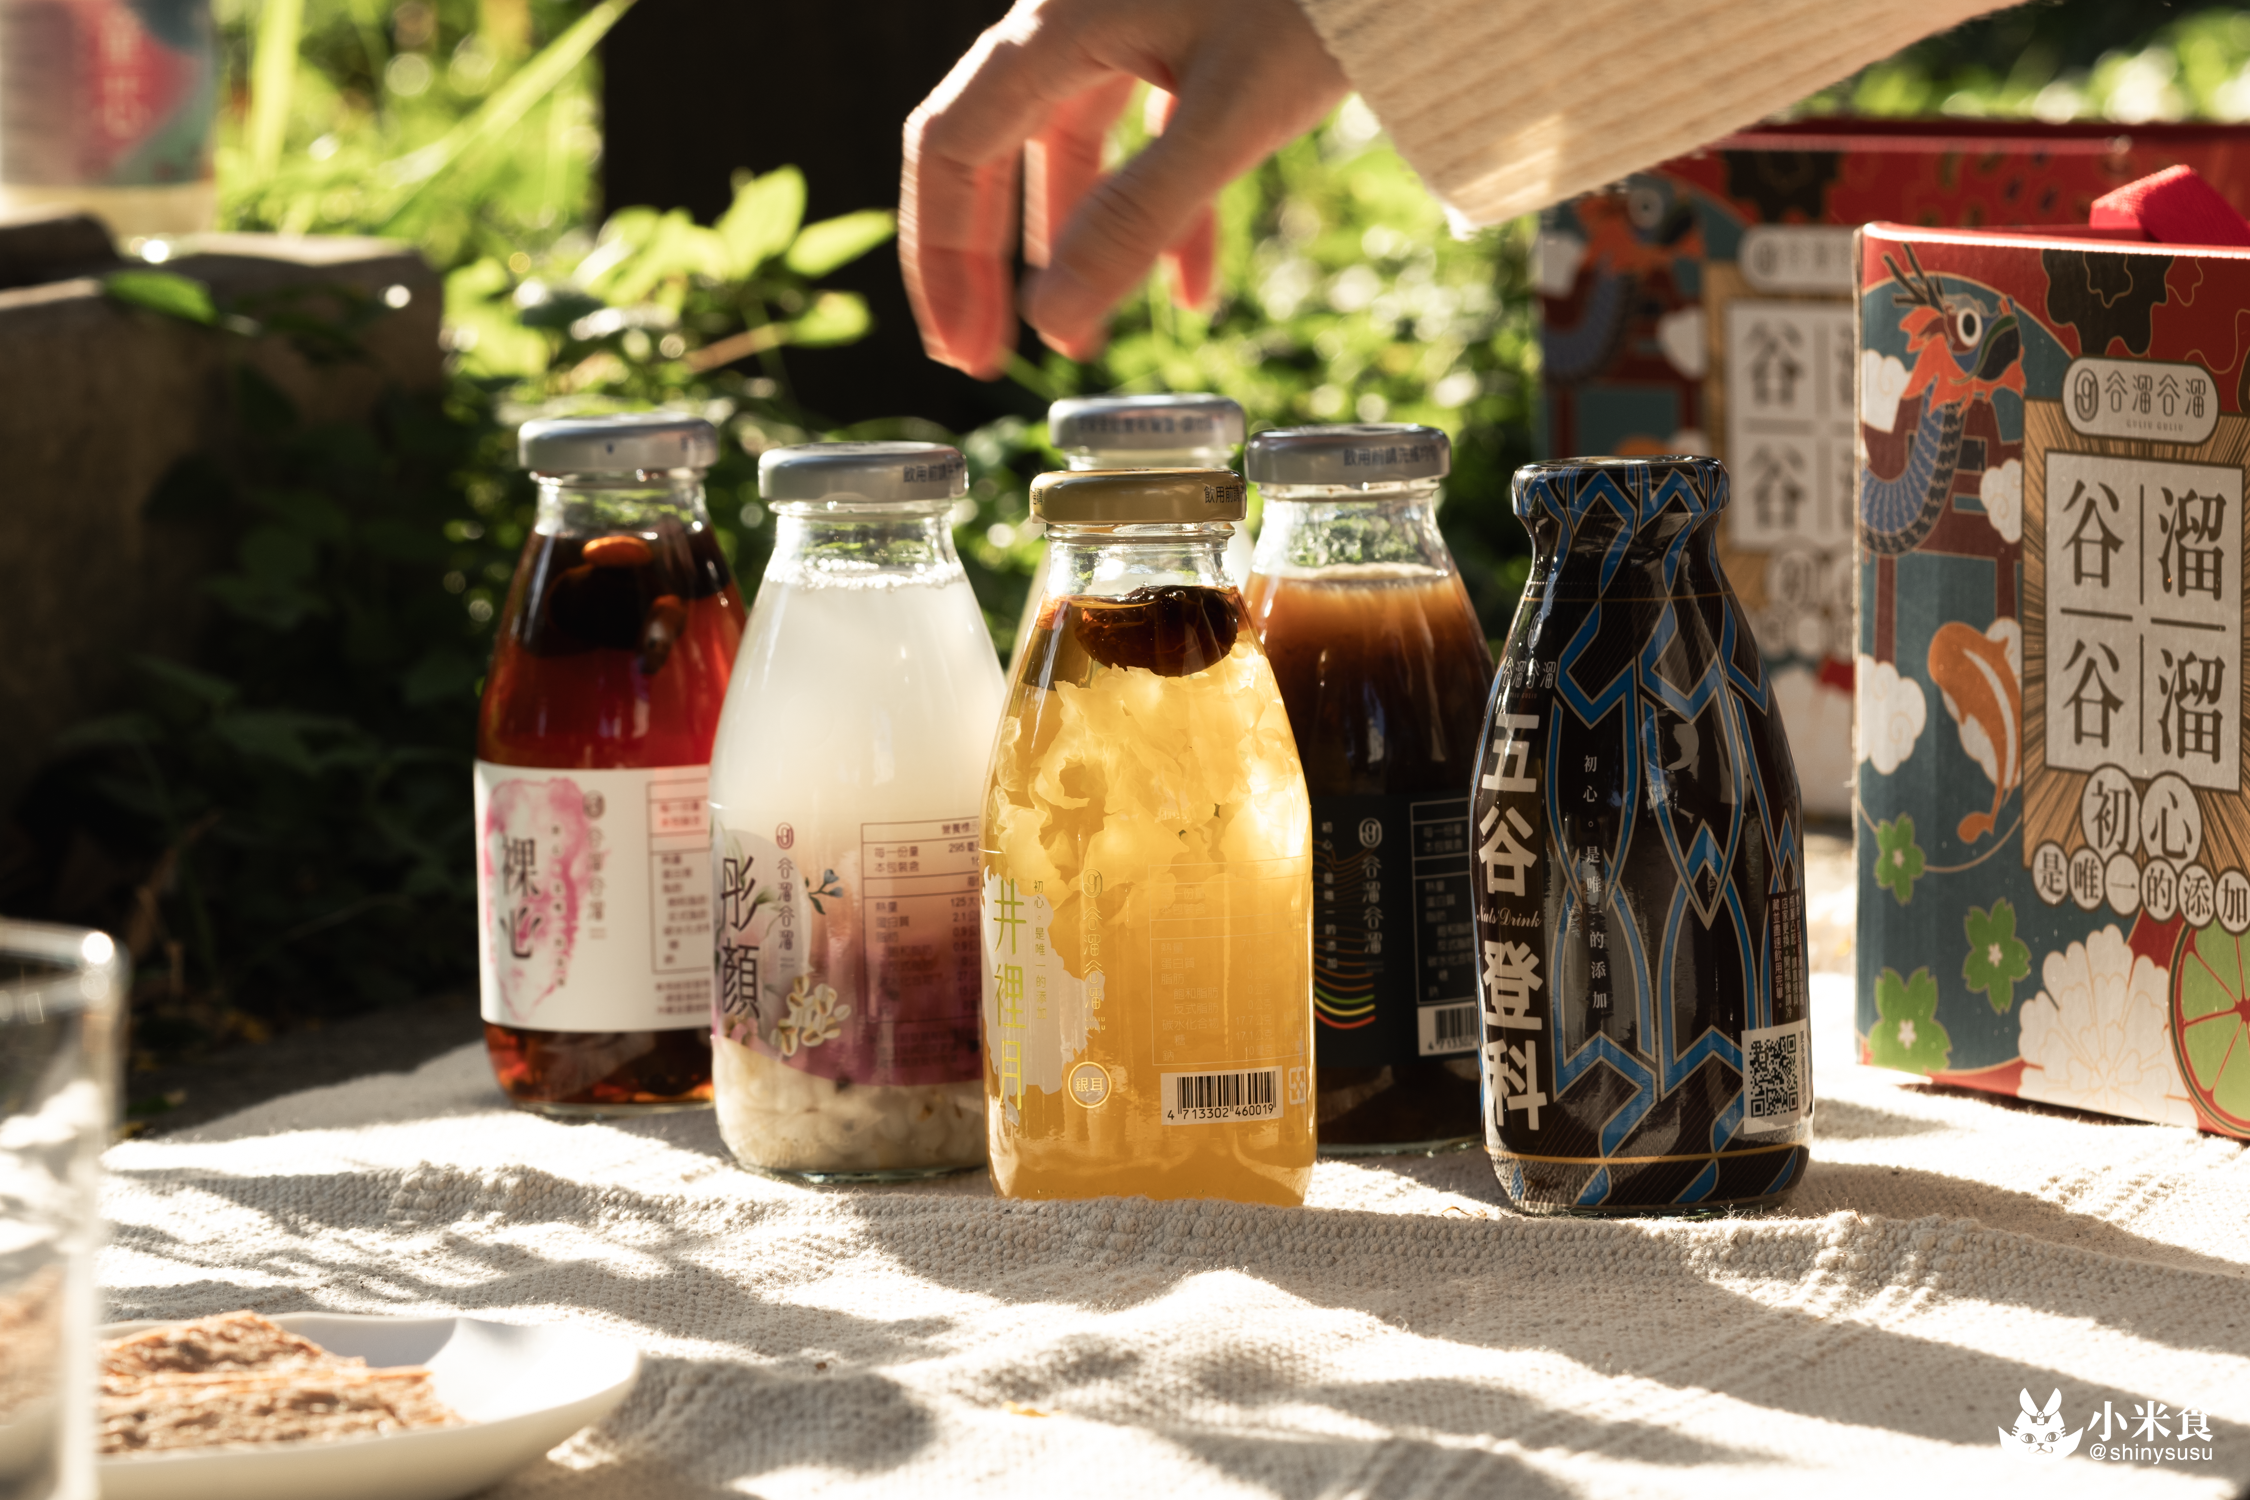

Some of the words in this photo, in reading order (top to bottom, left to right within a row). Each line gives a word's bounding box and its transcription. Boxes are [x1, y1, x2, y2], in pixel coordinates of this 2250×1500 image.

[2105, 369, 2206, 418] 谷溜谷溜
[2090, 780, 2193, 860] 初心
[777, 857, 795, 951] 谷溜谷溜
[2039, 852, 2248, 924] 是唯一的添加
[721, 855, 760, 1020] 彤顏
[1033, 879, 1047, 1020] 初心。是唯一的添加
[1083, 906, 1105, 1010] 谷溜谷溜
[1160, 956, 1196, 970] 蛋白質
[993, 877, 1027, 1111] 井裡月
[1160, 972, 1185, 986] 脂肪
[1173, 986, 1219, 1001] 飽和脂肪
[1173, 1001, 1219, 1016] 反式脂肪
[1075, 1077, 1105, 1093] 銀耳
[1167, 1109, 1175, 1120] 4
[1182, 1107, 1229, 1120] 713302
[1235, 1098, 1274, 1117] 460019
